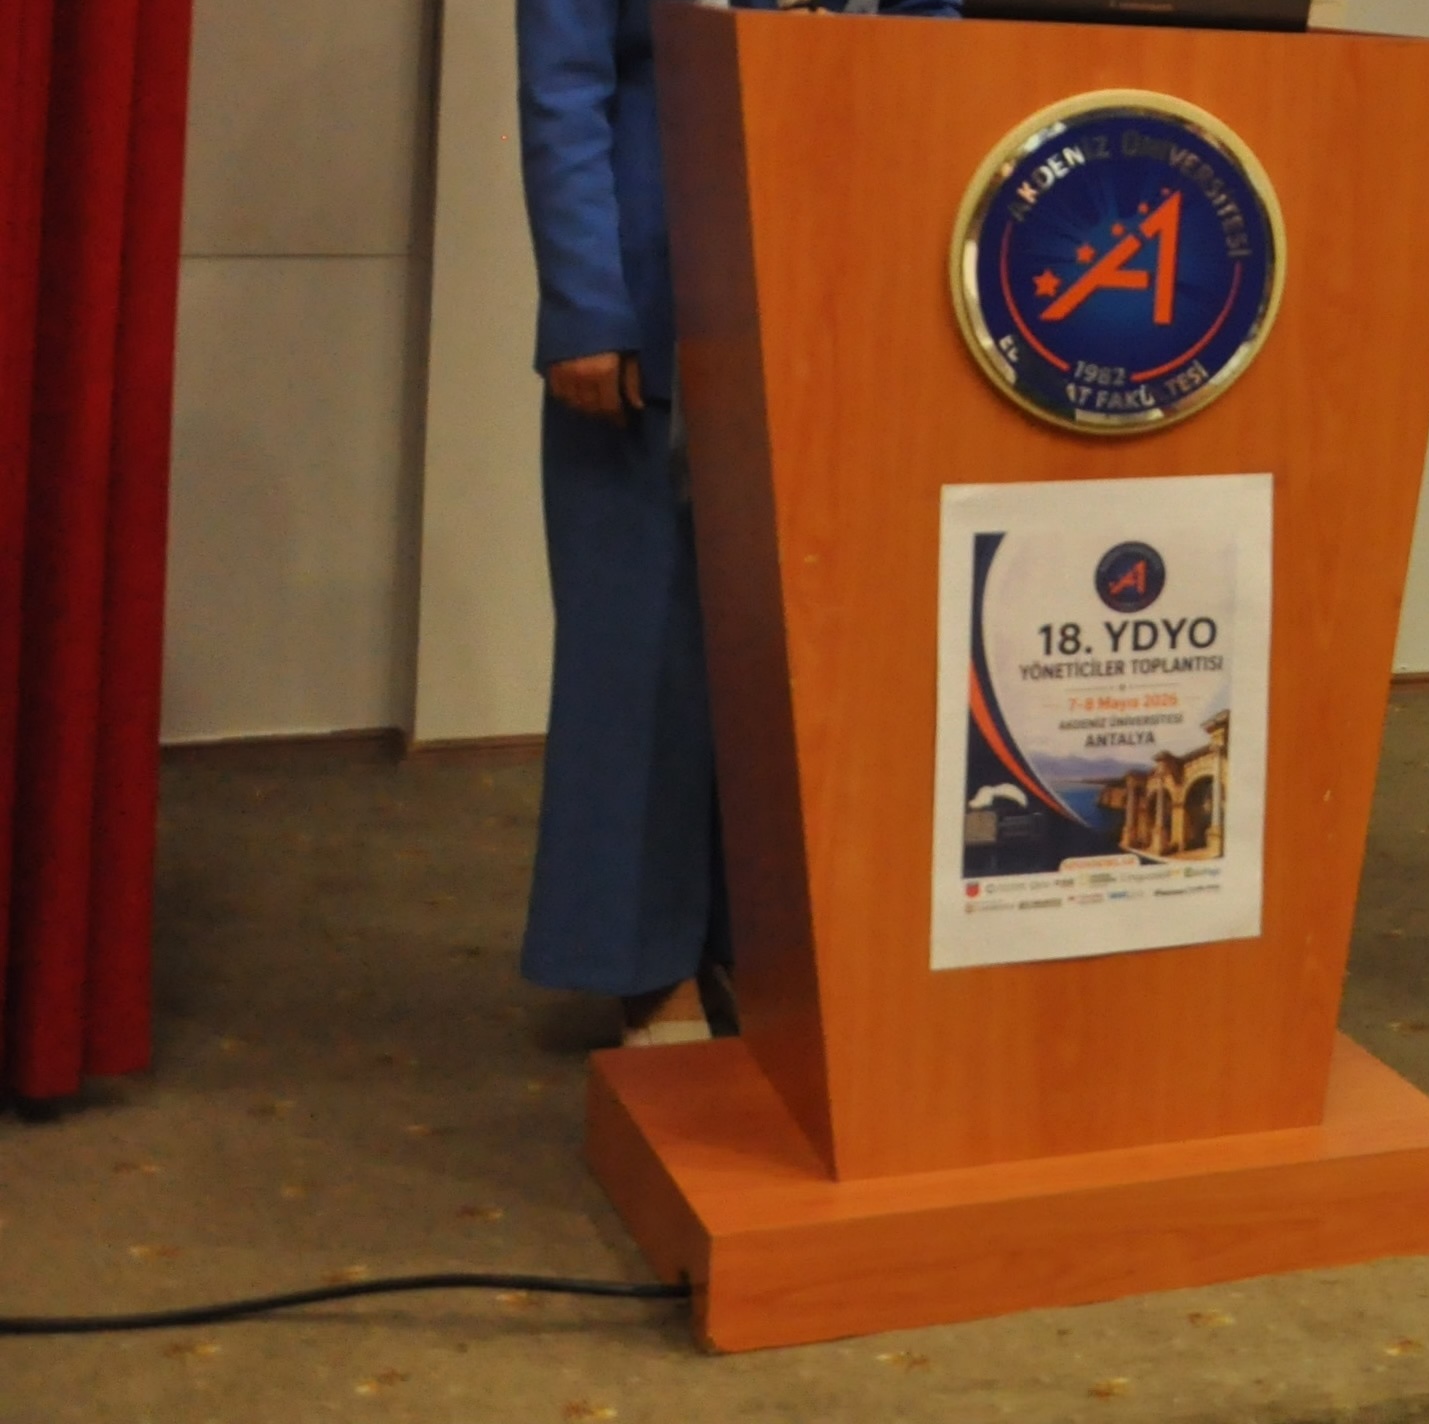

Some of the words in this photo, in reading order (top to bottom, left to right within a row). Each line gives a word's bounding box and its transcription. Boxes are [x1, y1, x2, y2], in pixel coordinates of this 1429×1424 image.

[1073, 360, 1126, 385] 1982
[1095, 359, 1211, 410] FAKÜTESİ
[1038, 623, 1093, 656] 18.
[1104, 617, 1217, 653] YDYO
[1019, 656, 1125, 681] YÖNETİCİLER
[1131, 654, 1223, 676] TOPLANTISI
[1085, 731, 1156, 749] ANTALYA
